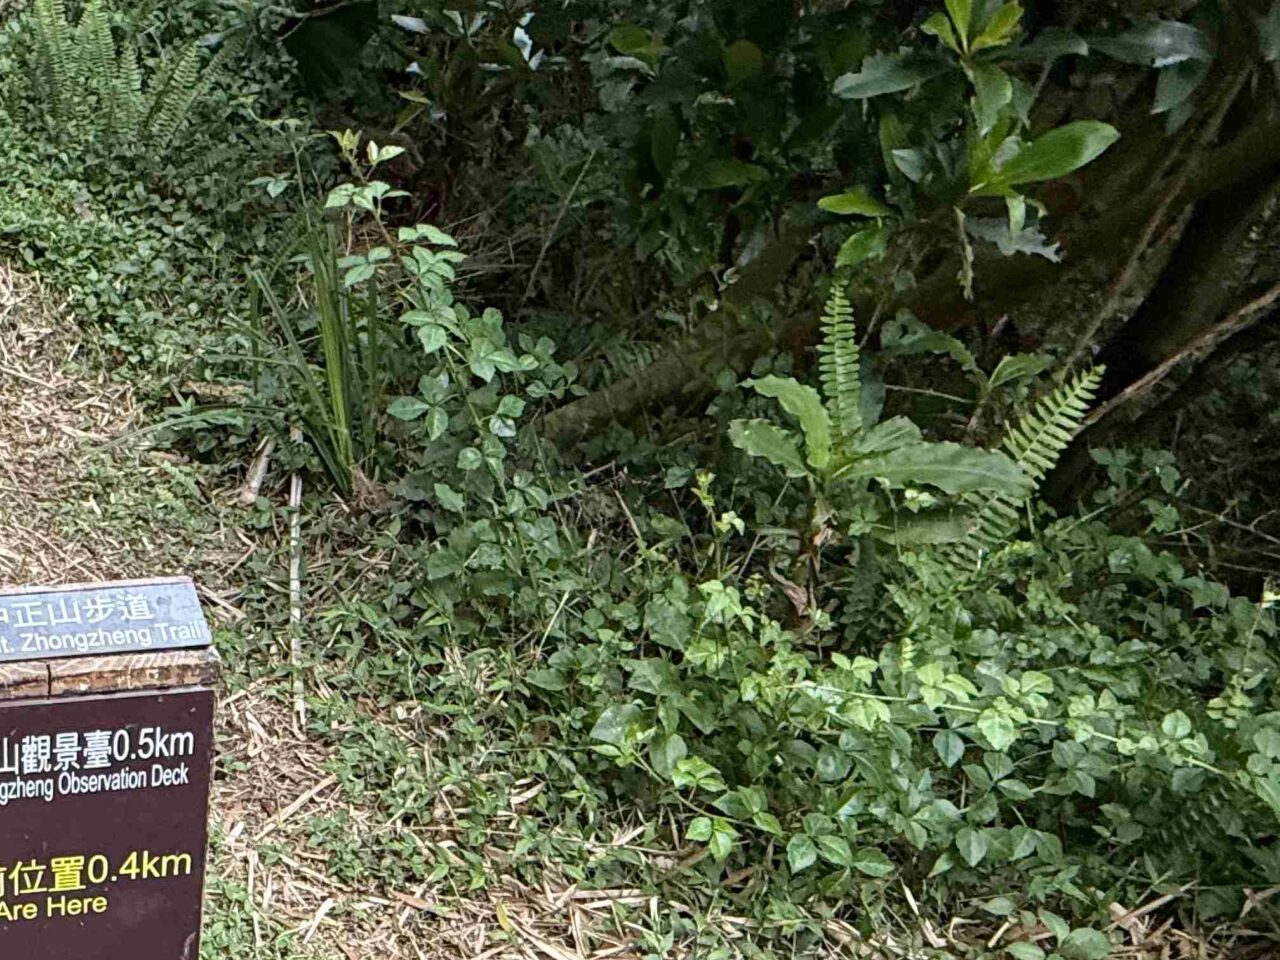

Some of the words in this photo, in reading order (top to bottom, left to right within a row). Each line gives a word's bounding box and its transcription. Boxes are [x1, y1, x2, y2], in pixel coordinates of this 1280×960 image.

[21, 626, 152, 654] Zhongzheng
[158, 617, 203, 641] Trail
[58, 766, 147, 795] Observation
[151, 762, 189, 786] Deck
[46, 894, 108, 917] Here
